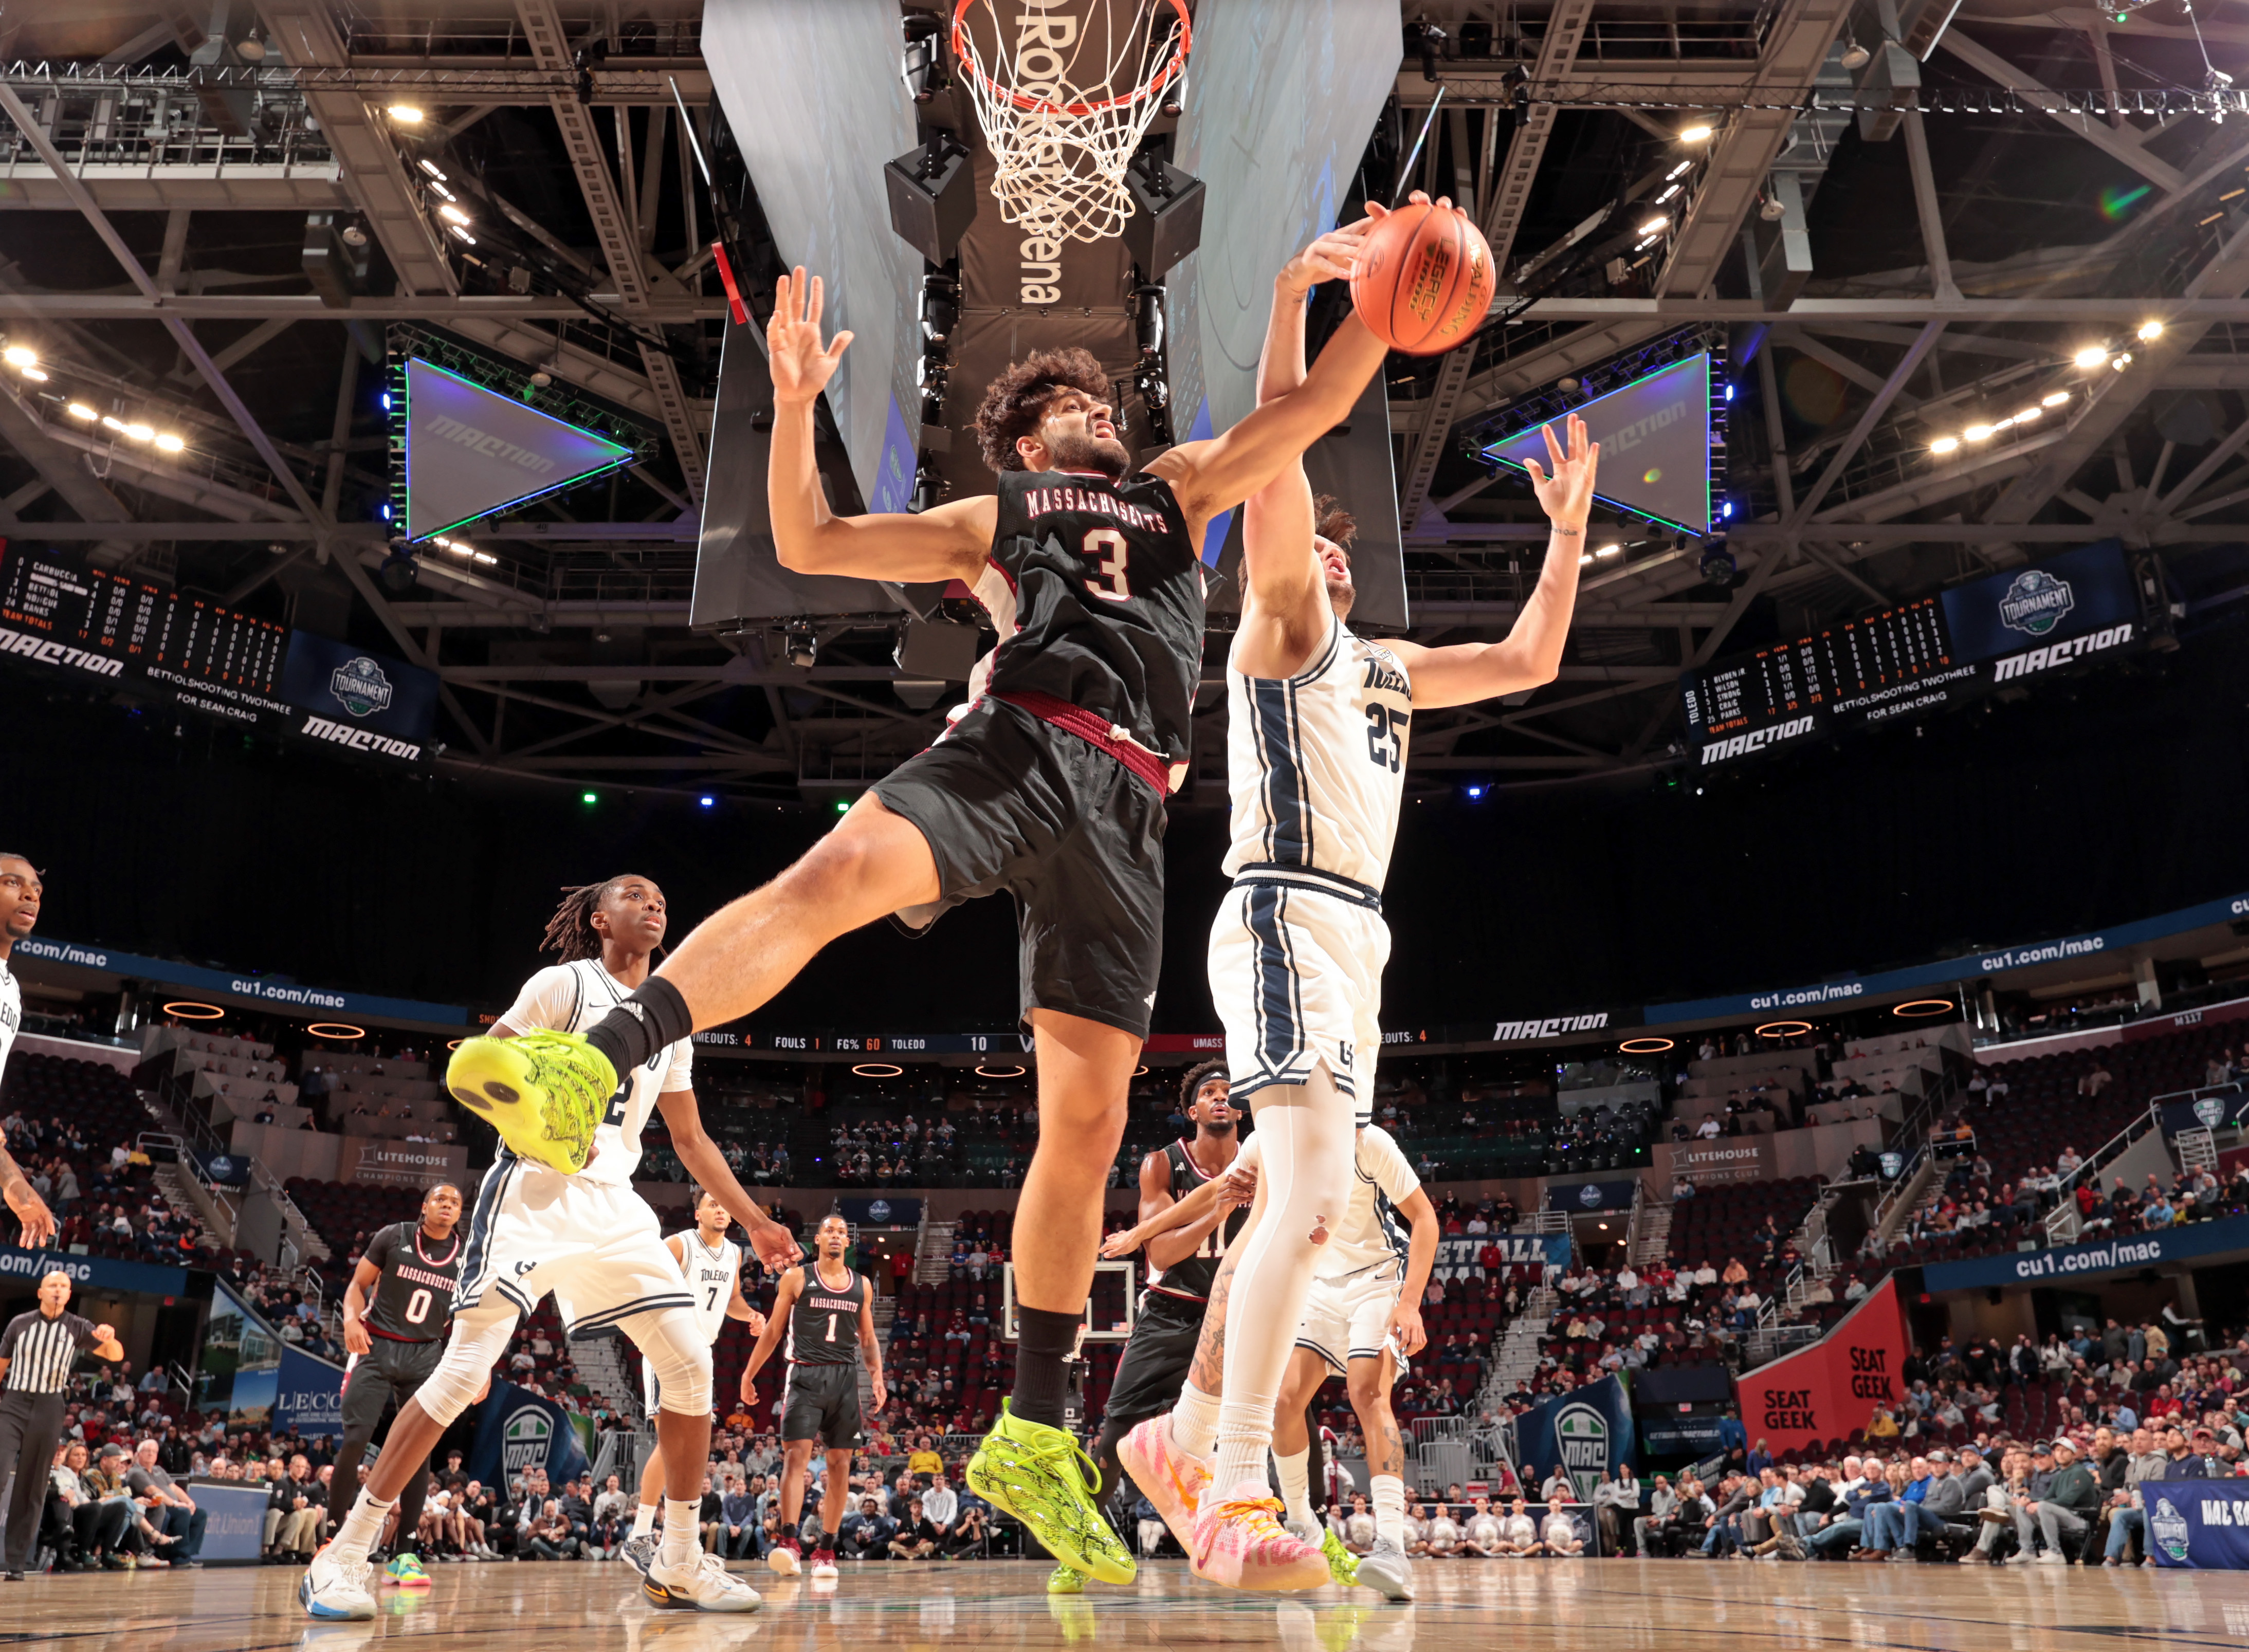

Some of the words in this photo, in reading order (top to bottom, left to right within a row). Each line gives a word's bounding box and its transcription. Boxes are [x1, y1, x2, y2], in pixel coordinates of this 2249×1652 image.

[425, 414, 555, 473] MACTION
[1599, 400, 1687, 461] ACTION
[1025, 487, 1169, 535] MASSACHUSETTS
[1081, 527, 1132, 602] 3
[23, 601, 49, 617] BANKS
[2003, 587, 2069, 623] TOURNAMENT
[0, 628, 124, 678] MACTION
[1994, 623, 2133, 683] MACTION
[176, 692, 197, 706] FOR
[335, 673, 390, 705] TOURNAMENT
[1714, 680, 1740, 693] WILSON
[1717, 688, 1742, 702] STRONG
[1685, 690, 1700, 725] TOLEDO
[1718, 699, 1738, 711] CRAIG
[1720, 707, 1742, 720] PARKS
[1867, 707, 1887, 721] FOR
[301, 715, 420, 761] MACTION
[1365, 702, 1410, 774] 25
[1702, 715, 1814, 765] MACTION
[1982, 936, 2104, 971] cu1.com/mac
[232, 979, 345, 1008] cu1.com/mac
[1751, 982, 1862, 1009] cu1.com/mac
[1, 1002, 17, 1034] EDO
[1493, 1013, 1609, 1041] MACTION
[744, 1034, 752, 1047] 4
[775, 1037, 806, 1049] FOULS
[815, 1037, 819, 1050] 1
[837, 1039, 859, 1051] FG%
[866, 1038, 881, 1051] 60
[892, 1038, 925, 1050] TOLEDO
[971, 1036, 987, 1052] 10
[1193, 1038, 1223, 1049] UMASS
[1419, 1030, 1427, 1042] 4
[377, 1151, 448, 1167] LITEHOUSE
[1688, 1147, 1759, 1163] LITEHOUSE
[356, 1171, 417, 1183] CHAMPIONS
[1673, 1171, 1730, 1183] CAMPIONS
[1734, 1169, 1760, 1179] CLUB
[2017, 1240, 2161, 1277] cu1.com/mac
[397, 1264, 457, 1292] MASSACHUSETTS
[701, 1269, 729, 1282] TOLEDO
[406, 1289, 432, 1324] 0
[707, 1287, 717, 1311] 7
[810, 1297, 859, 1313] MASSACHUSETTS
[825, 1313, 838, 1342] 1
[1851, 1347, 1886, 1372] SEAT
[1765, 1390, 1811, 1409] SEAT
[1852, 1375, 1894, 1401] GEEK
[1765, 1411, 1817, 1430] GEEK
[506, 1442, 546, 1470] MAC
[1565, 1440, 1606, 1467] MAC
[2201, 1499, 2233, 1526] MAC
